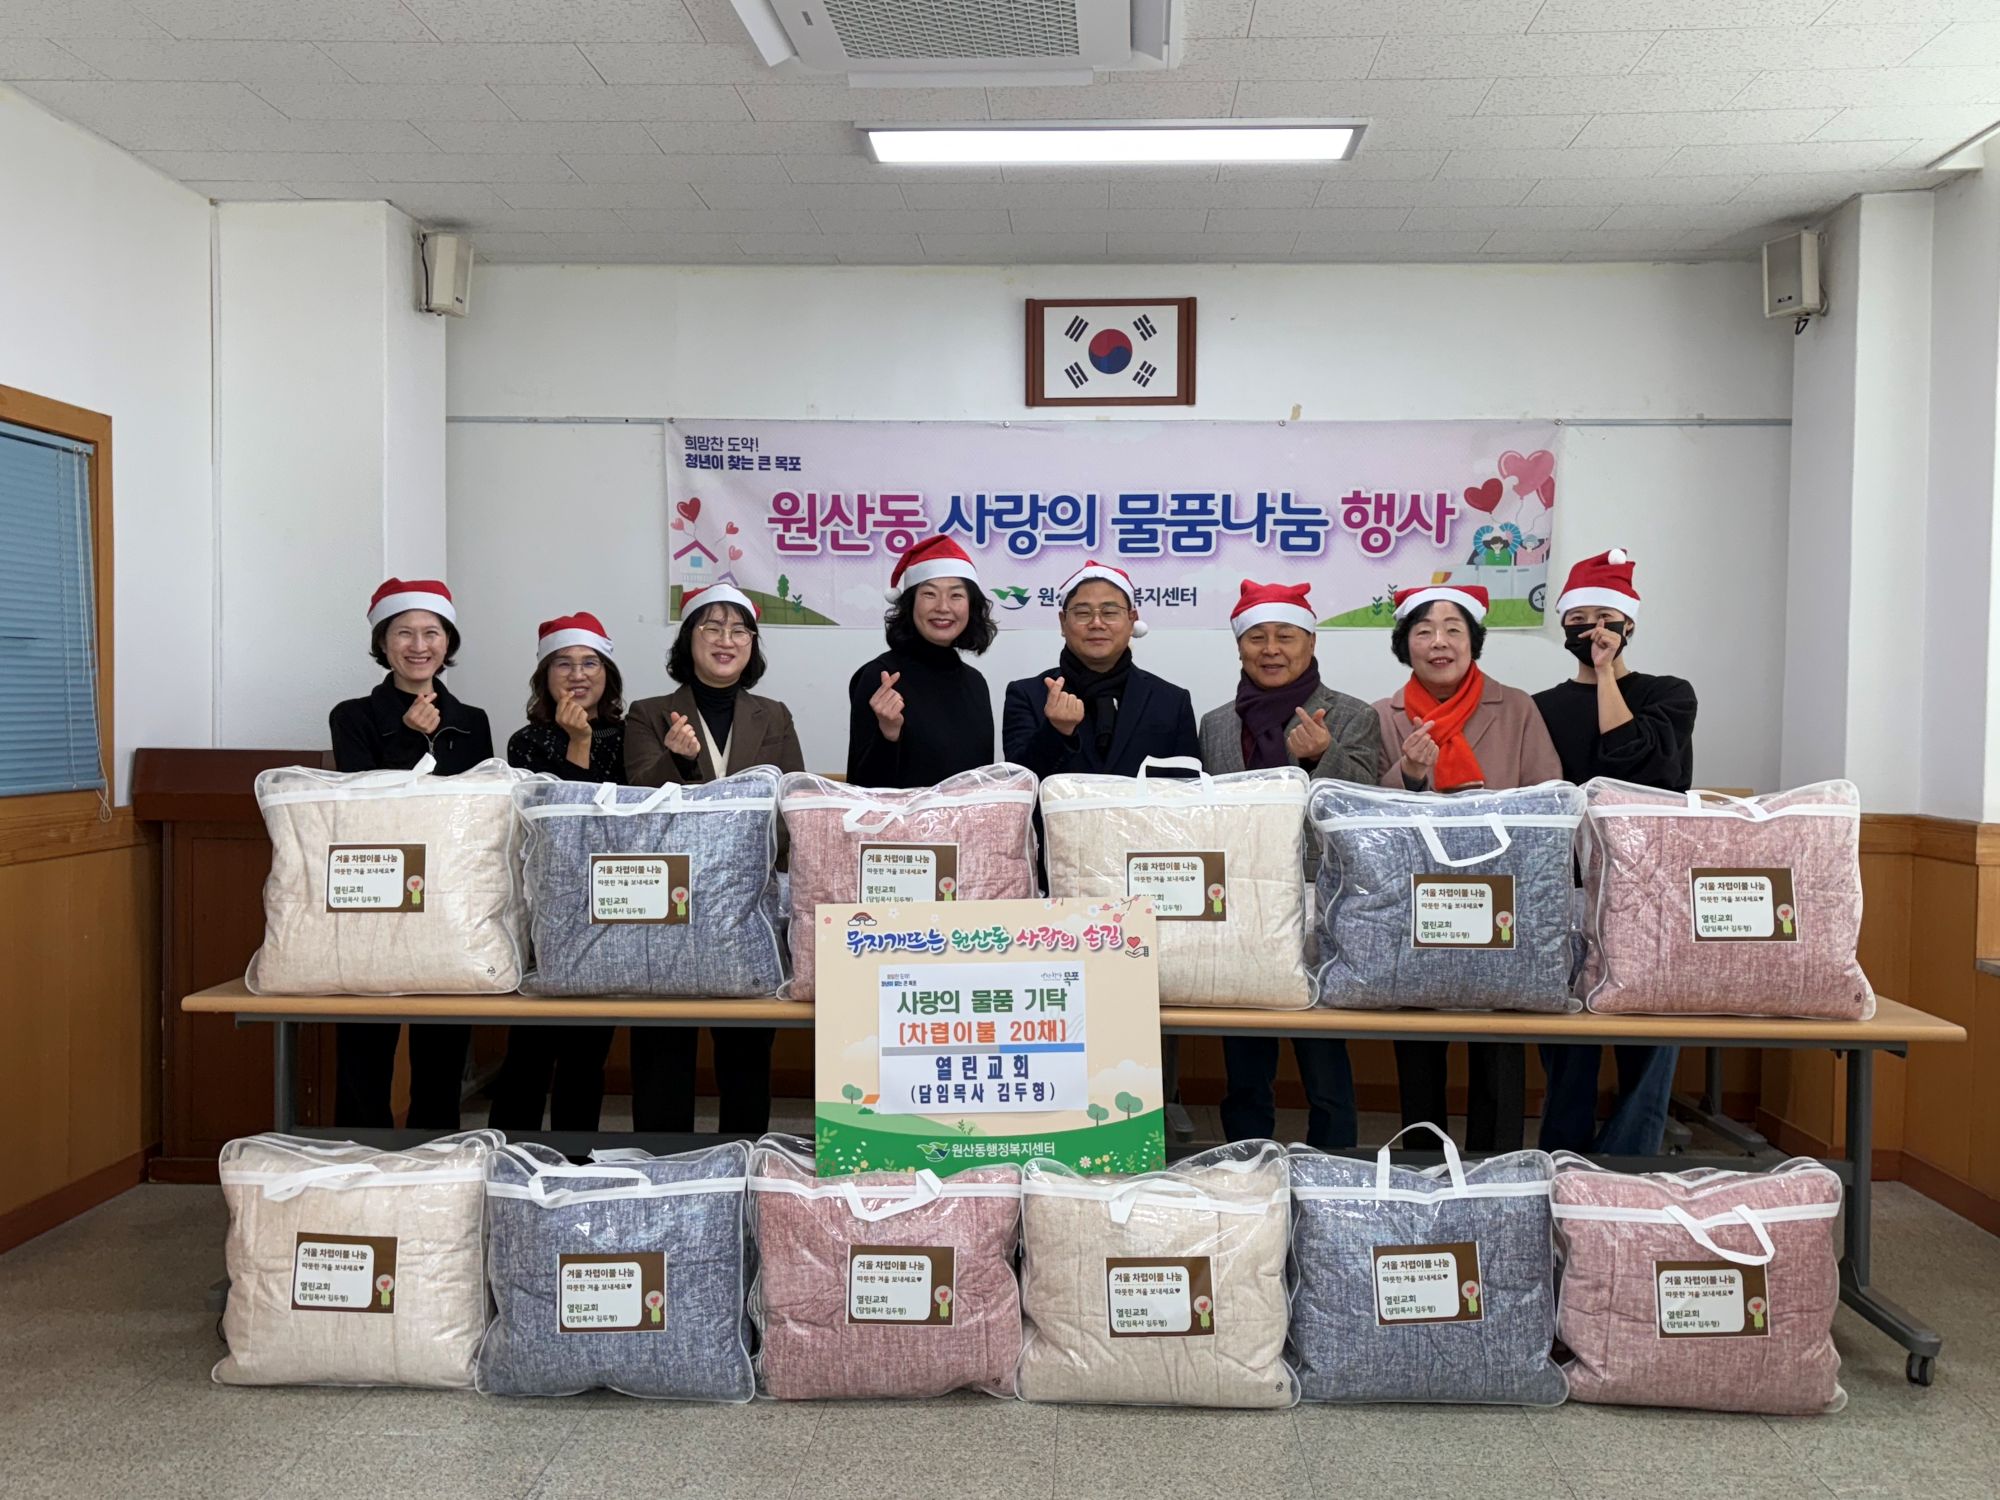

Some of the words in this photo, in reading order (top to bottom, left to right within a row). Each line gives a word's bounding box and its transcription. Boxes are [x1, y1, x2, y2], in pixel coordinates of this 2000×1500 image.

[684, 435, 724, 452] 희망찬
[728, 436, 759, 452] 도약!
[685, 453, 724, 470] 청년이
[727, 454, 754, 471] 찾는
[758, 455, 771, 471] 큰
[775, 456, 802, 472] 목포
[767, 490, 929, 553] 원산동
[938, 492, 1097, 556] 사랑의
[1110, 491, 1330, 554] 물품나눔
[1340, 489, 1456, 554] 행사
[335, 855, 349, 863] 겨울
[383, 854, 398, 863] 나눔
[867, 854, 882, 863] 겨울
[915, 854, 930, 864] 나눔
[598, 865, 613, 875] 겨울
[647, 865, 662, 874] 나눔
[1134, 862, 1149, 871] 겨울
[1182, 862, 1197, 870] 나눔
[333, 886, 364, 895] 열린교회
[866, 886, 896, 894] 열린교회
[1700, 882, 1715, 890] 겨울
[1750, 882, 1765, 890] 나눔
[1421, 889, 1436, 897] 겨울
[1471, 889, 1486, 897] 나눔
[598, 897, 628, 906] 열린교회
[1701, 914, 1732, 923] 열린교회
[1421, 921, 1452, 929] 열린교회
[847, 928, 945, 955] 무지개뜨는
[951, 926, 1011, 950] 원산동
[1016, 926, 1077, 949] 사랑의
[1082, 924, 1123, 946] 손길
[897, 990, 960, 1015] 사랑의
[971, 989, 1014, 1014] 물품
[1025, 987, 1068, 1012] 기탁
[899, 1021, 996, 1045] [차렵이불
[1010, 1019, 1067, 1042] 20채]
[936, 1055, 1029, 1081] 열린교회
[911, 1083, 984, 1104] (담임목사
[997, 1081, 1055, 1103] 김두형)
[952, 1141, 1055, 1158] 원산동행정복지센터
[302, 1248, 317, 1257] 겨울
[352, 1250, 368, 1260] 나눔
[321, 1263, 333, 1271] 겨울
[858, 1261, 873, 1270] 겨울
[909, 1261, 925, 1270] 나눔
[1382, 1261, 1398, 1270] 겨울
[1434, 1259, 1449, 1268] 나눔
[567, 1269, 582, 1278] 겨울
[618, 1268, 635, 1277] 나눔
[1115, 1273, 1130, 1282] 겨울
[1166, 1272, 1182, 1281] 나눔
[1664, 1276, 1681, 1285] 겨울
[1719, 1275, 1735, 1284] 나눔
[300, 1282, 331, 1291] 열린교회
[856, 1295, 888, 1304] 열린교회
[1384, 1295, 1416, 1305] 열린교회
[567, 1304, 598, 1313] 열린교회
[1116, 1308, 1148, 1318] 열린교회
[1666, 1310, 1700, 1319] 열린교회
